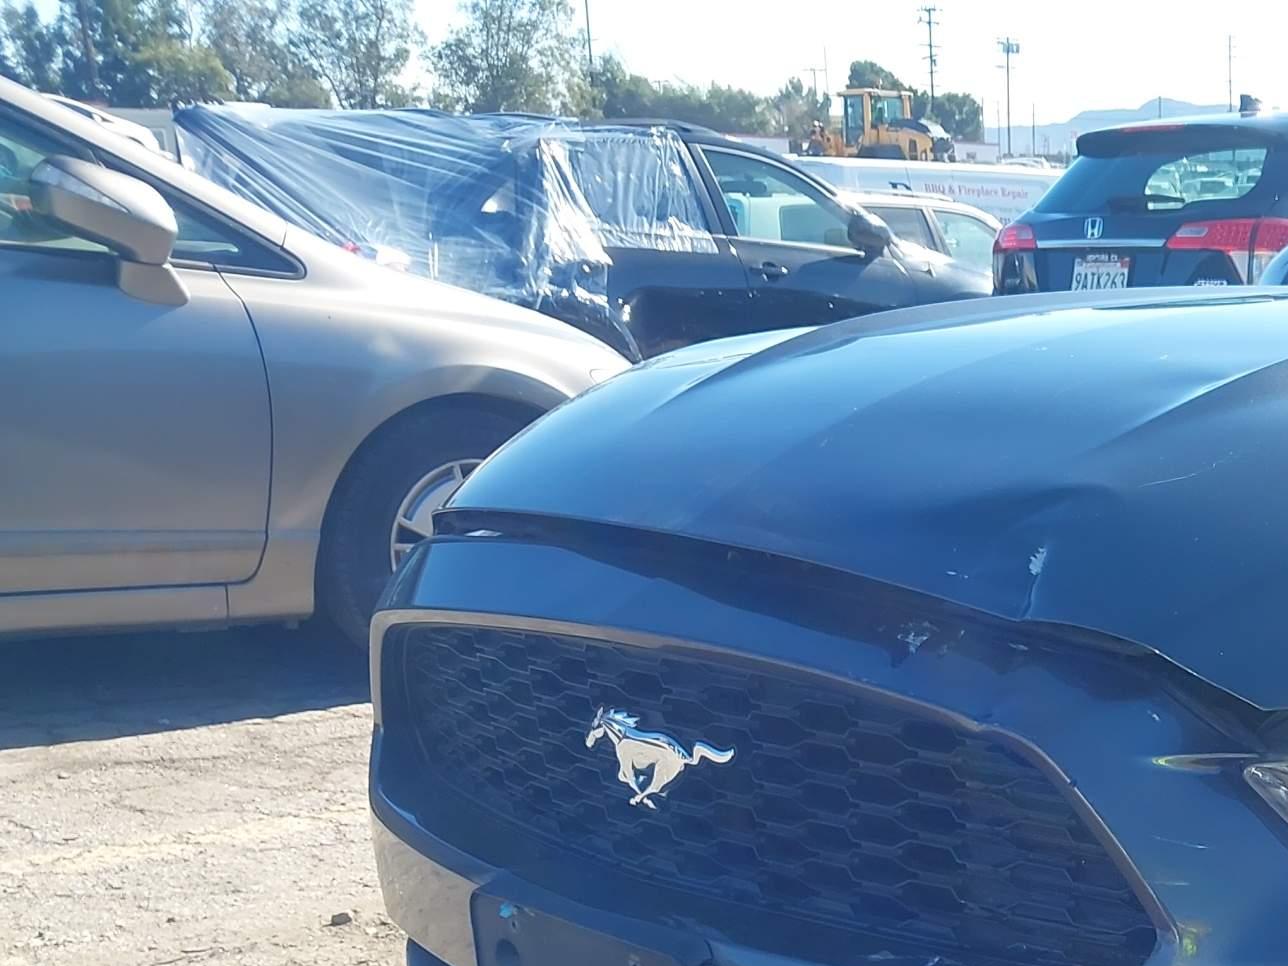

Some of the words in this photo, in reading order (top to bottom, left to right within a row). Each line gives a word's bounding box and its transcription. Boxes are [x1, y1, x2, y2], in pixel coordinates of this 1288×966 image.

[948, 184, 955, 195] &
[958, 184, 998, 198] Fireplace
[1000, 187, 1029, 200] Repair
